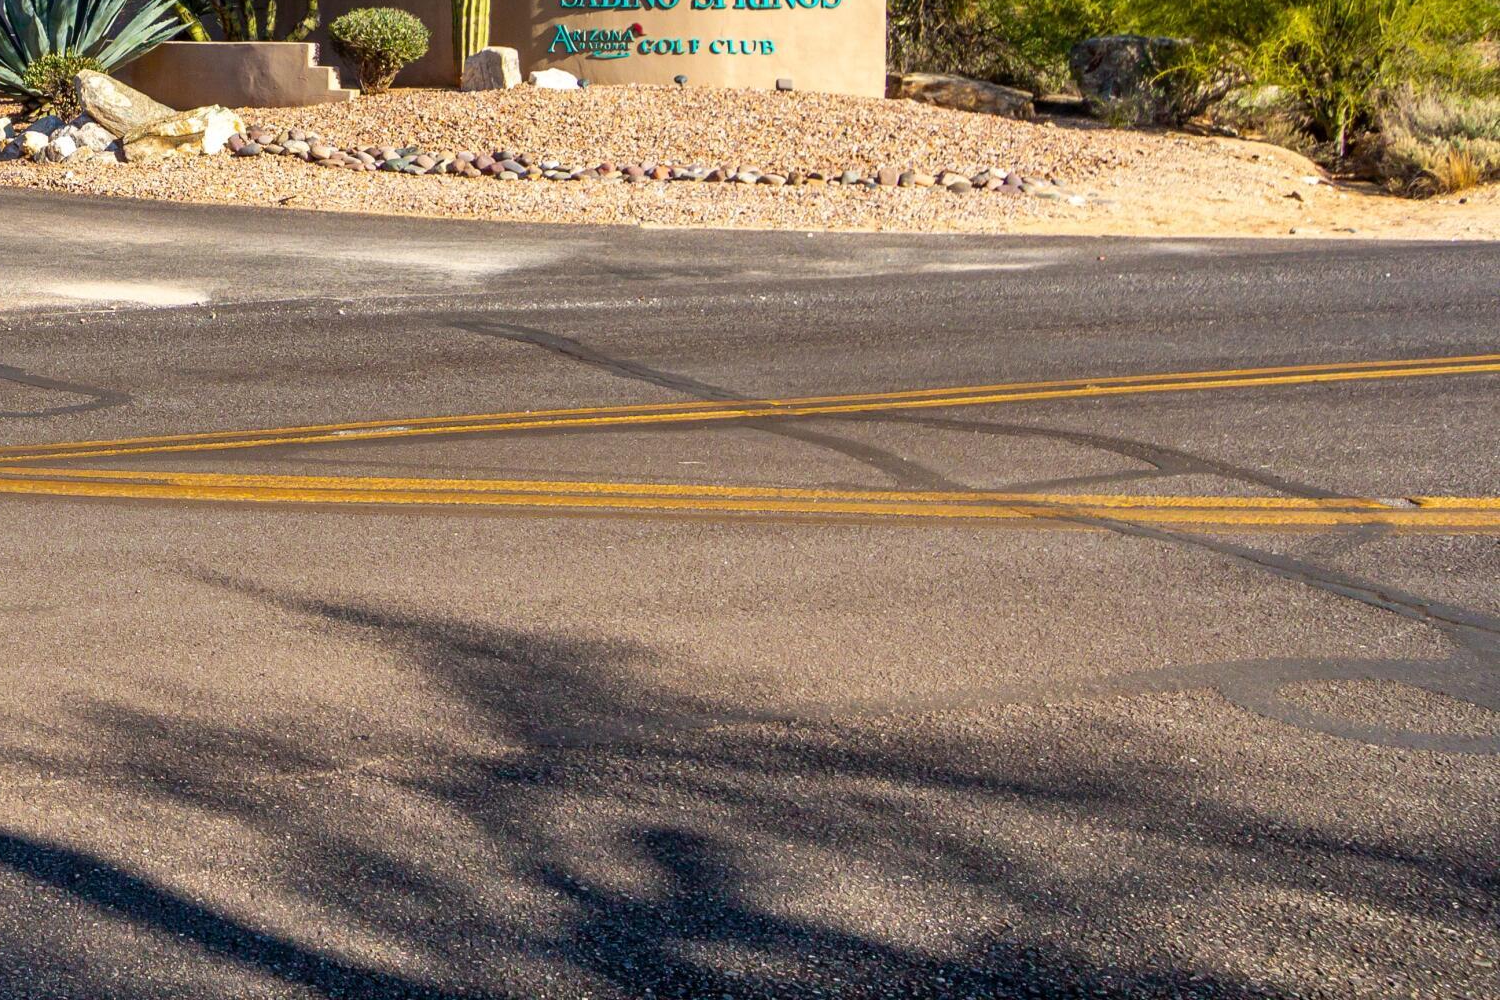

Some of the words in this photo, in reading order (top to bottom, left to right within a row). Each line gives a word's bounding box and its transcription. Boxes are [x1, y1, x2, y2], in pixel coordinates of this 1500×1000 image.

[548, 24, 634, 52] ARIZONA
[639, 39, 700, 55] GOLF
[710, 39, 775, 55] CLUB
